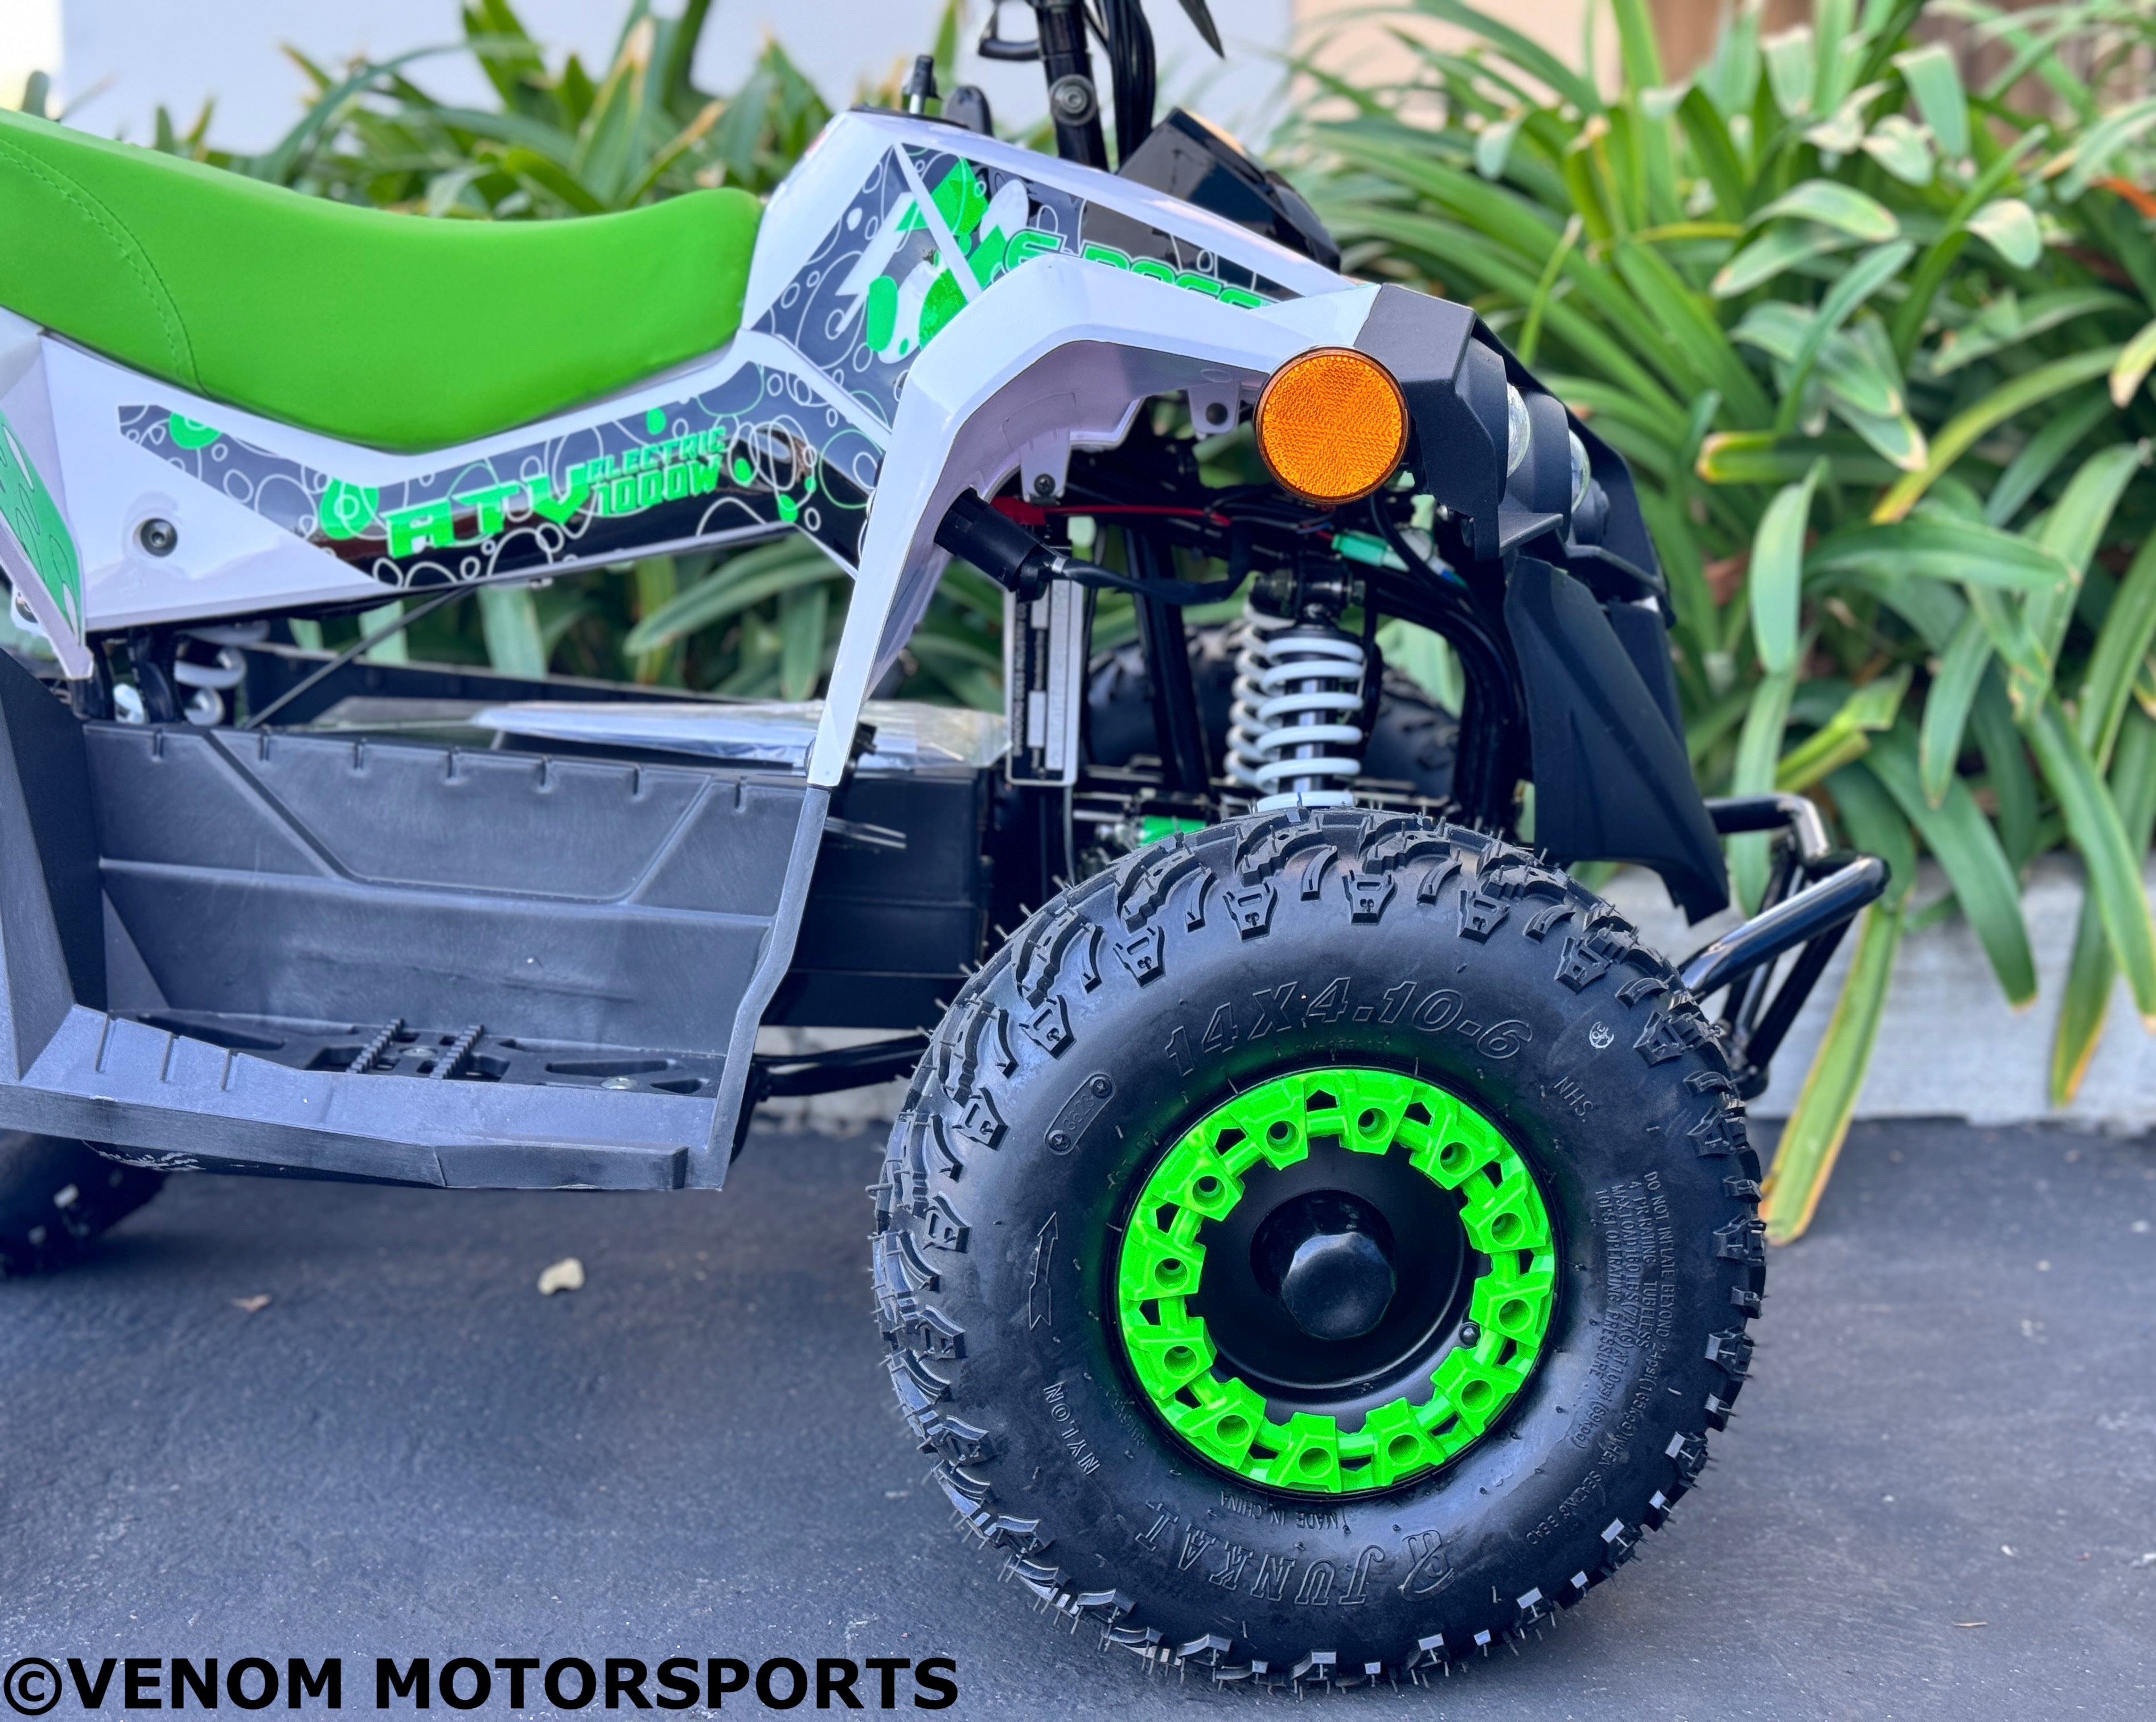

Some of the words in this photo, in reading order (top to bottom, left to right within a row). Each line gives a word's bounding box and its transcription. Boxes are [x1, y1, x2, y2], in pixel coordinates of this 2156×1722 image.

[590, 426, 726, 481] ELECTRIC
[380, 464, 589, 559] ATV
[591, 456, 723, 517] 1000W
[1164, 976, 1533, 1077] 14X4.10-6
[1644, 1171, 1661, 1190] DO
[1651, 1195, 1669, 1221] NOT
[1605, 1229, 1623, 1302] OPERATING
[1628, 1180, 1641, 1190] 4
[1635, 1282, 1656, 1349] TUBELESS
[1657, 1226, 1675, 1277] INFLATE
[1656, 1284, 1675, 1338] BEYOND
[1590, 1310, 1619, 1379] PRESSURE
[1043, 1381, 1101, 1475] NYLON
[1219, 1490, 1263, 1519] CHINA
[1270, 1508, 1287, 1526] IN
[1295, 1510, 1338, 1530] MADE
[1558, 1470, 1603, 1518] SEATING
[1135, 1502, 1385, 1606] JUNKAI
